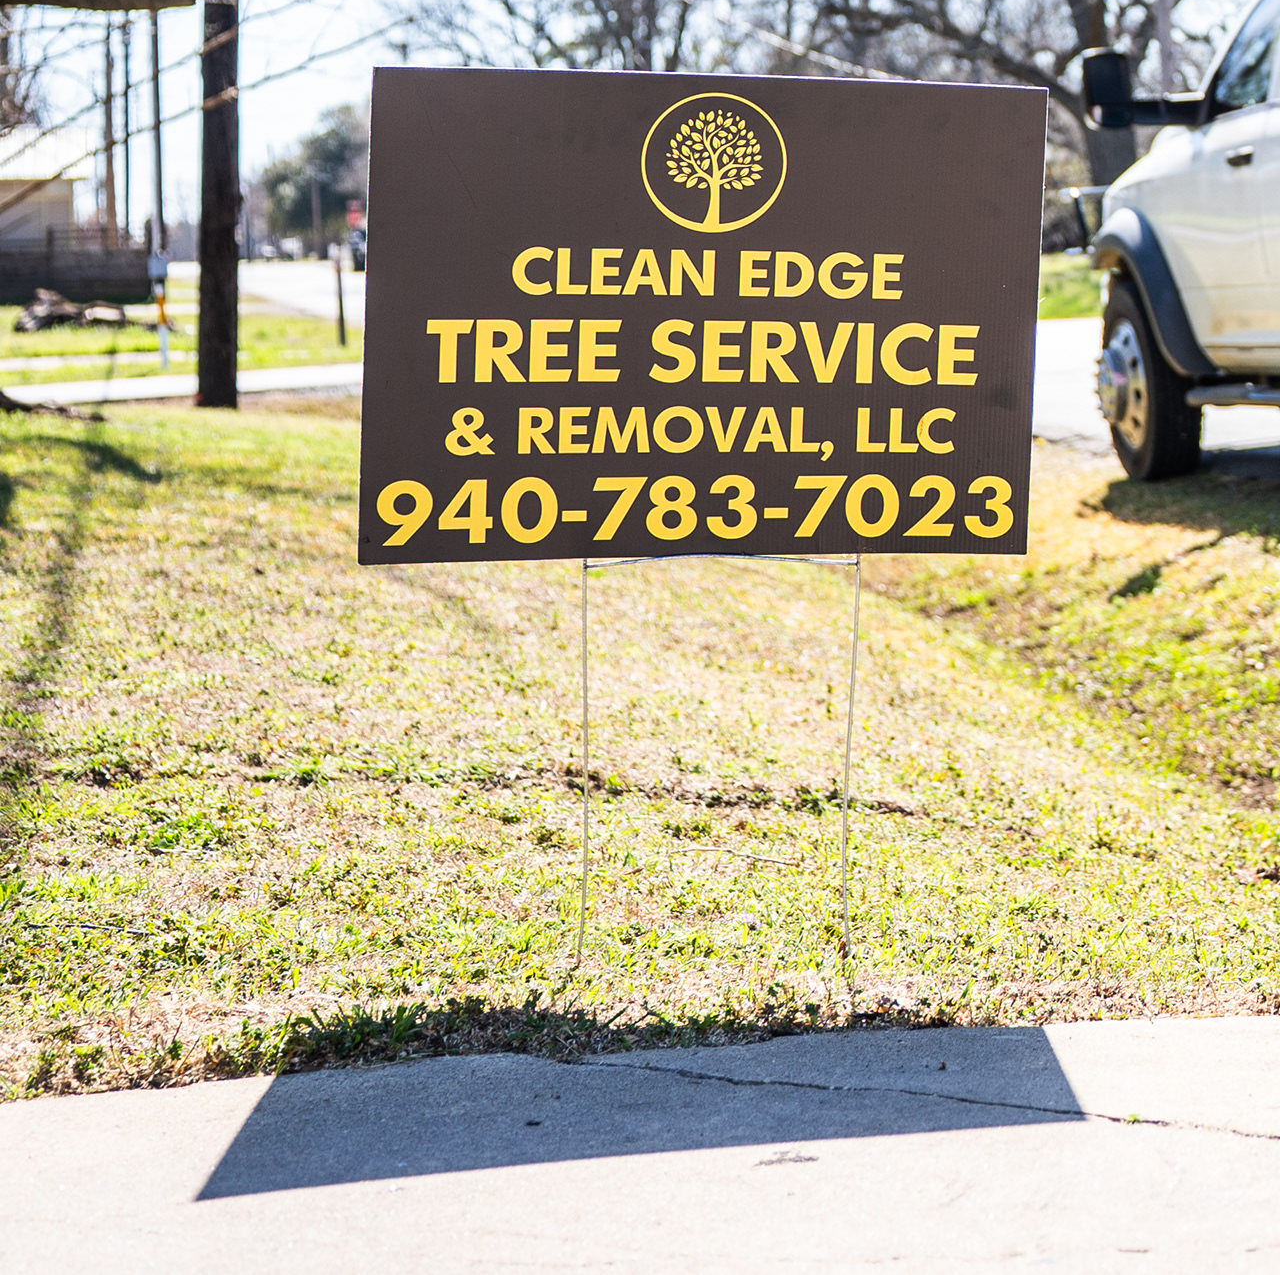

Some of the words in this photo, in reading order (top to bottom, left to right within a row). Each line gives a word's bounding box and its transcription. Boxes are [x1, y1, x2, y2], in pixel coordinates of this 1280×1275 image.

[511, 246, 716, 297] CLEAN
[738, 250, 905, 300] EDGE
[426, 319, 623, 383] TREE
[649, 319, 980, 386] SERVICE
[444, 407, 495, 456] &
[517, 406, 835, 462] REMOVAL,
[856, 407, 956, 455] LLC
[376, 474, 1015, 547] 940-783-7023
